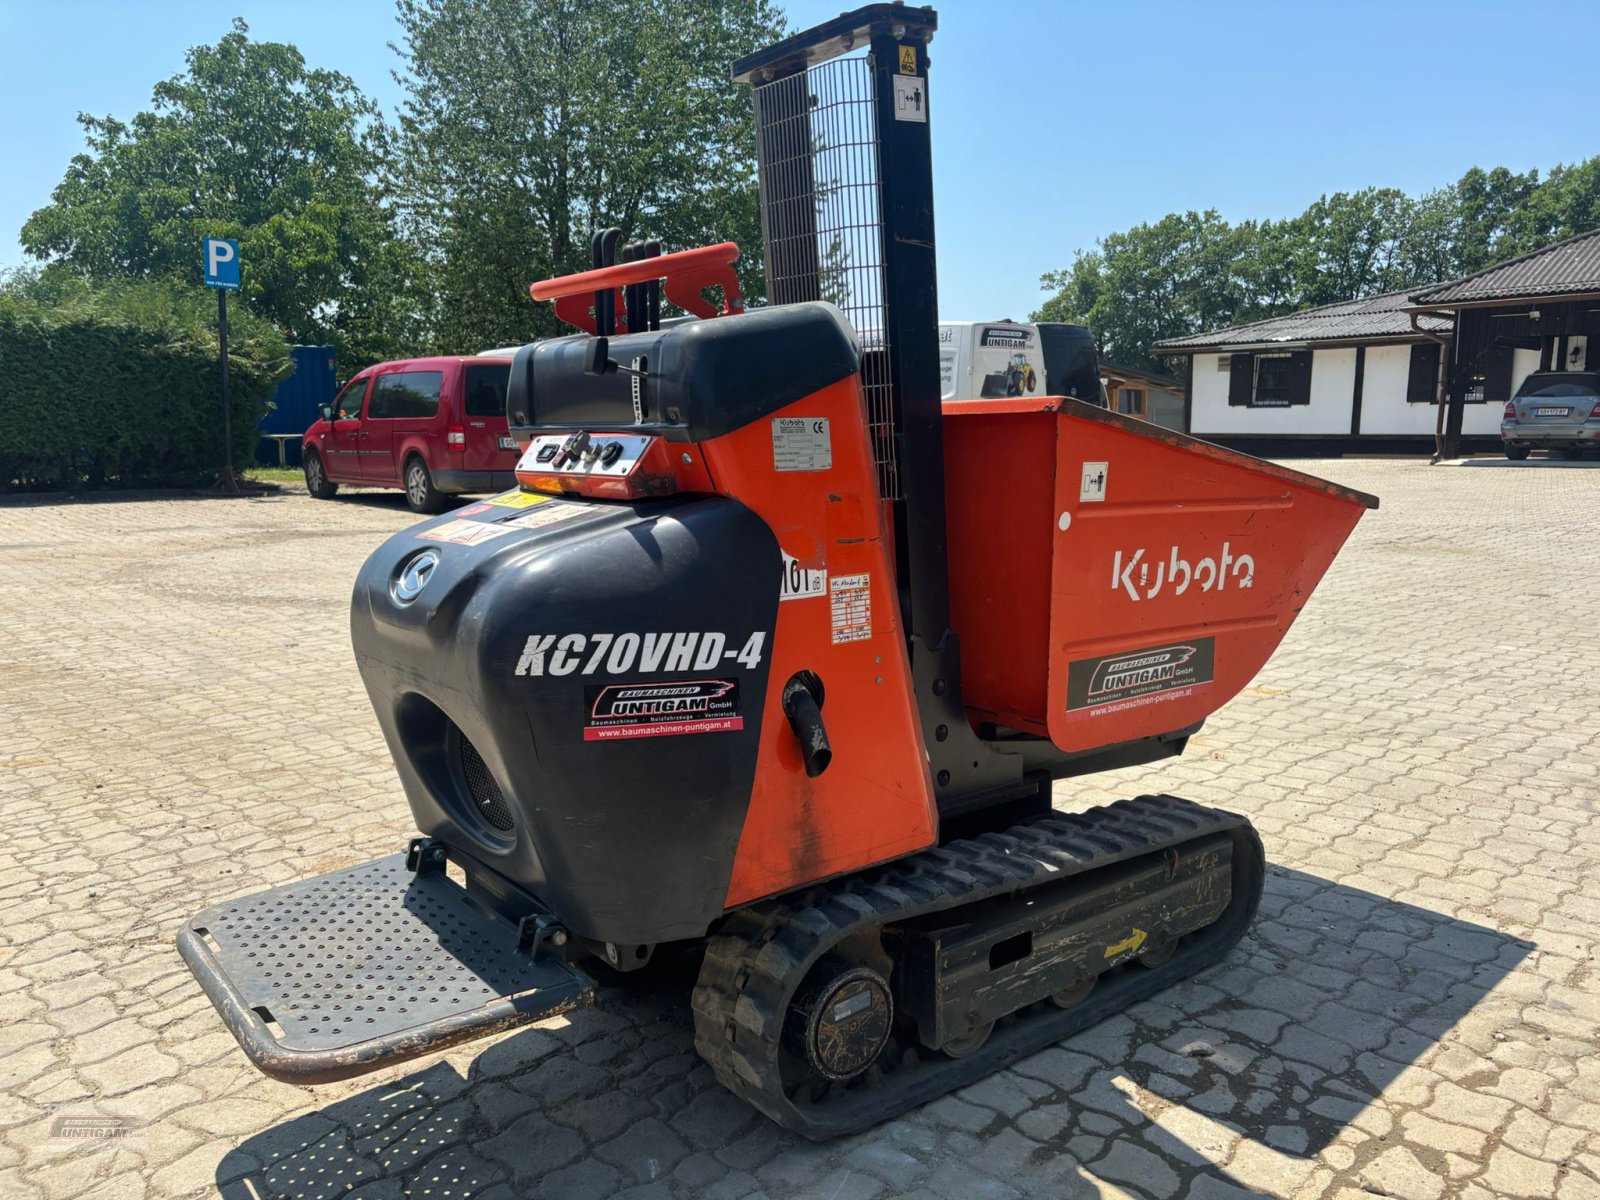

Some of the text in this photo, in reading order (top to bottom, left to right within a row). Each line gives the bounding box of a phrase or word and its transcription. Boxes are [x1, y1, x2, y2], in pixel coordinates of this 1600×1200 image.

[208, 239, 234, 277] P
[813, 422, 824, 434] CE
[1111, 541, 1255, 601] Kubota
[514, 631, 767, 677] KC70VHD-4
[1175, 667, 1194, 676] GmbH
[619, 687, 698, 698] BAUMASCHINEN
[709, 701, 732, 710] GmbH
[1089, 688, 1192, 717] www.baumaschinen-puntigam.at
[591, 718, 638, 726] Baumaschinen
[598, 721, 732, 737] www.baumaschinen-puntigam.at
